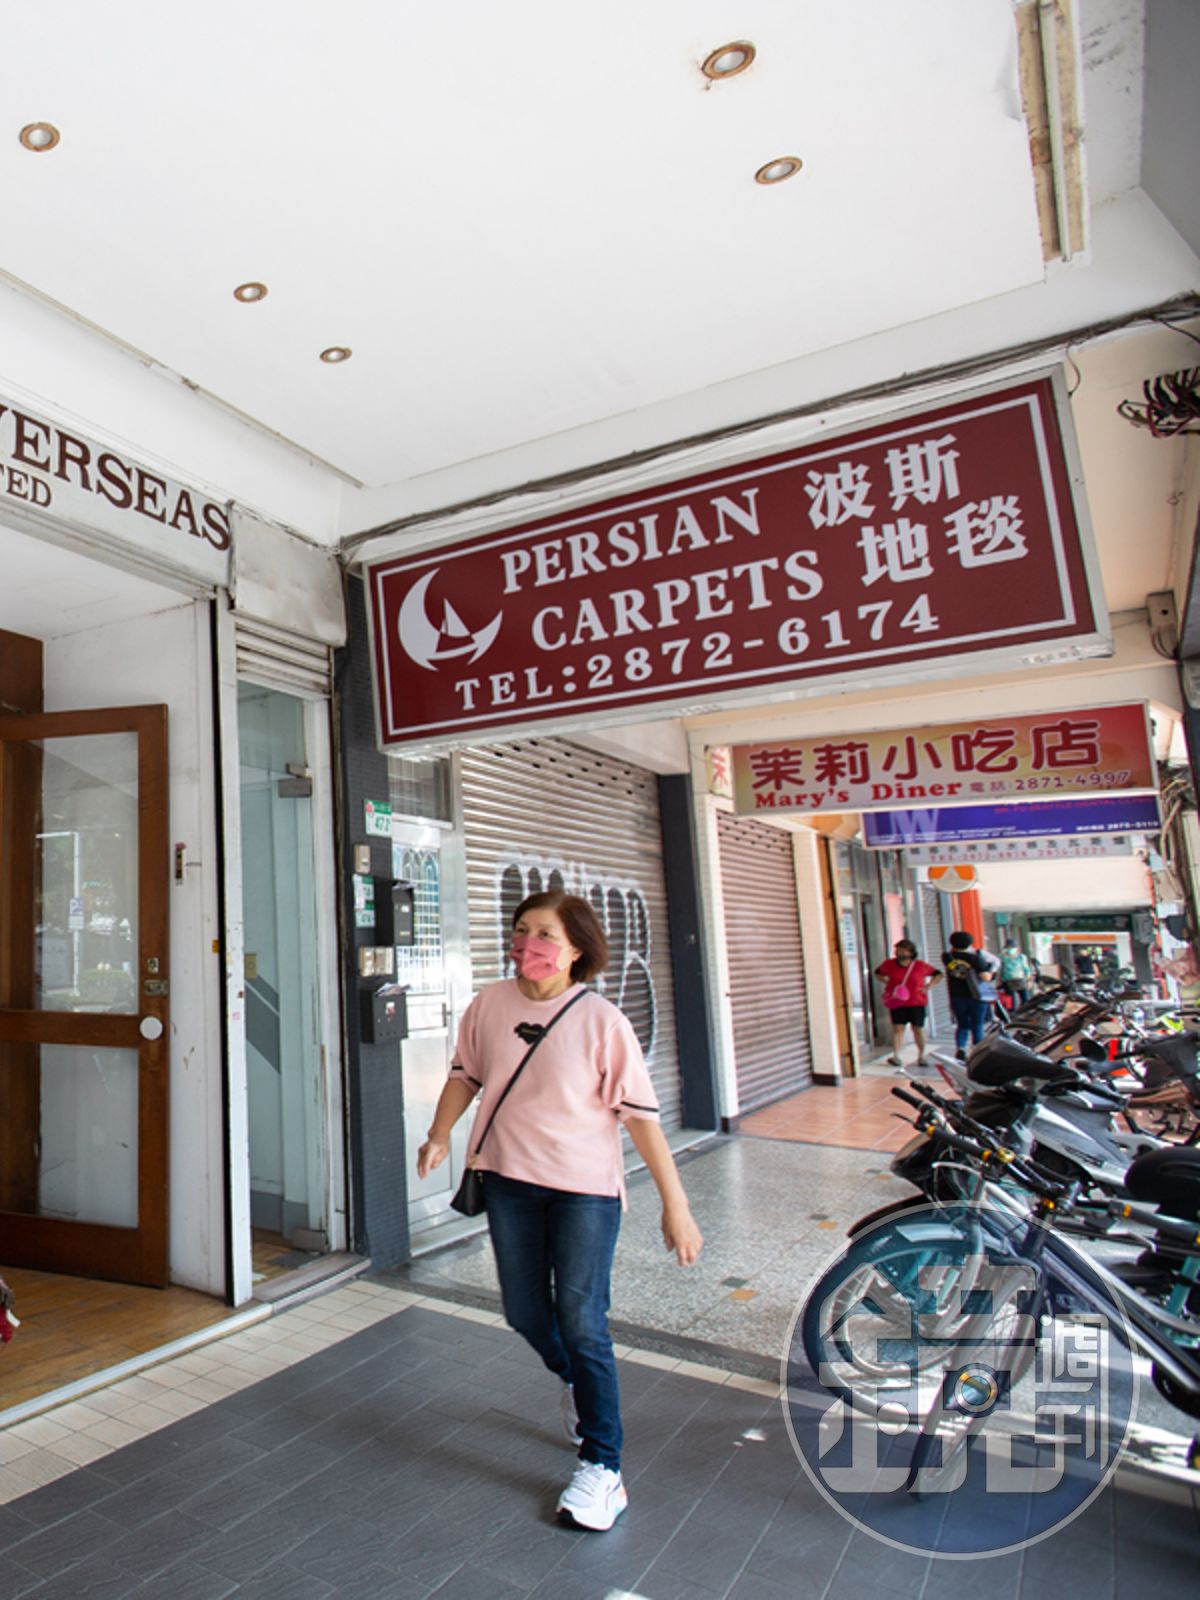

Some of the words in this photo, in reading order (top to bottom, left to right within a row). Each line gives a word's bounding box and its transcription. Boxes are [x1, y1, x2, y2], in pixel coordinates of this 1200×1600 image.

[803, 433, 961, 530] 波斯
[501, 487, 763, 595] PERSIAN
[856, 494, 1029, 588] 地毯
[531, 550, 824, 652] CARPETS
[749, 719, 1100, 791] 茉莉小吃店
[755, 787, 849, 809] Mary's
[871, 781, 963, 801] Diner
